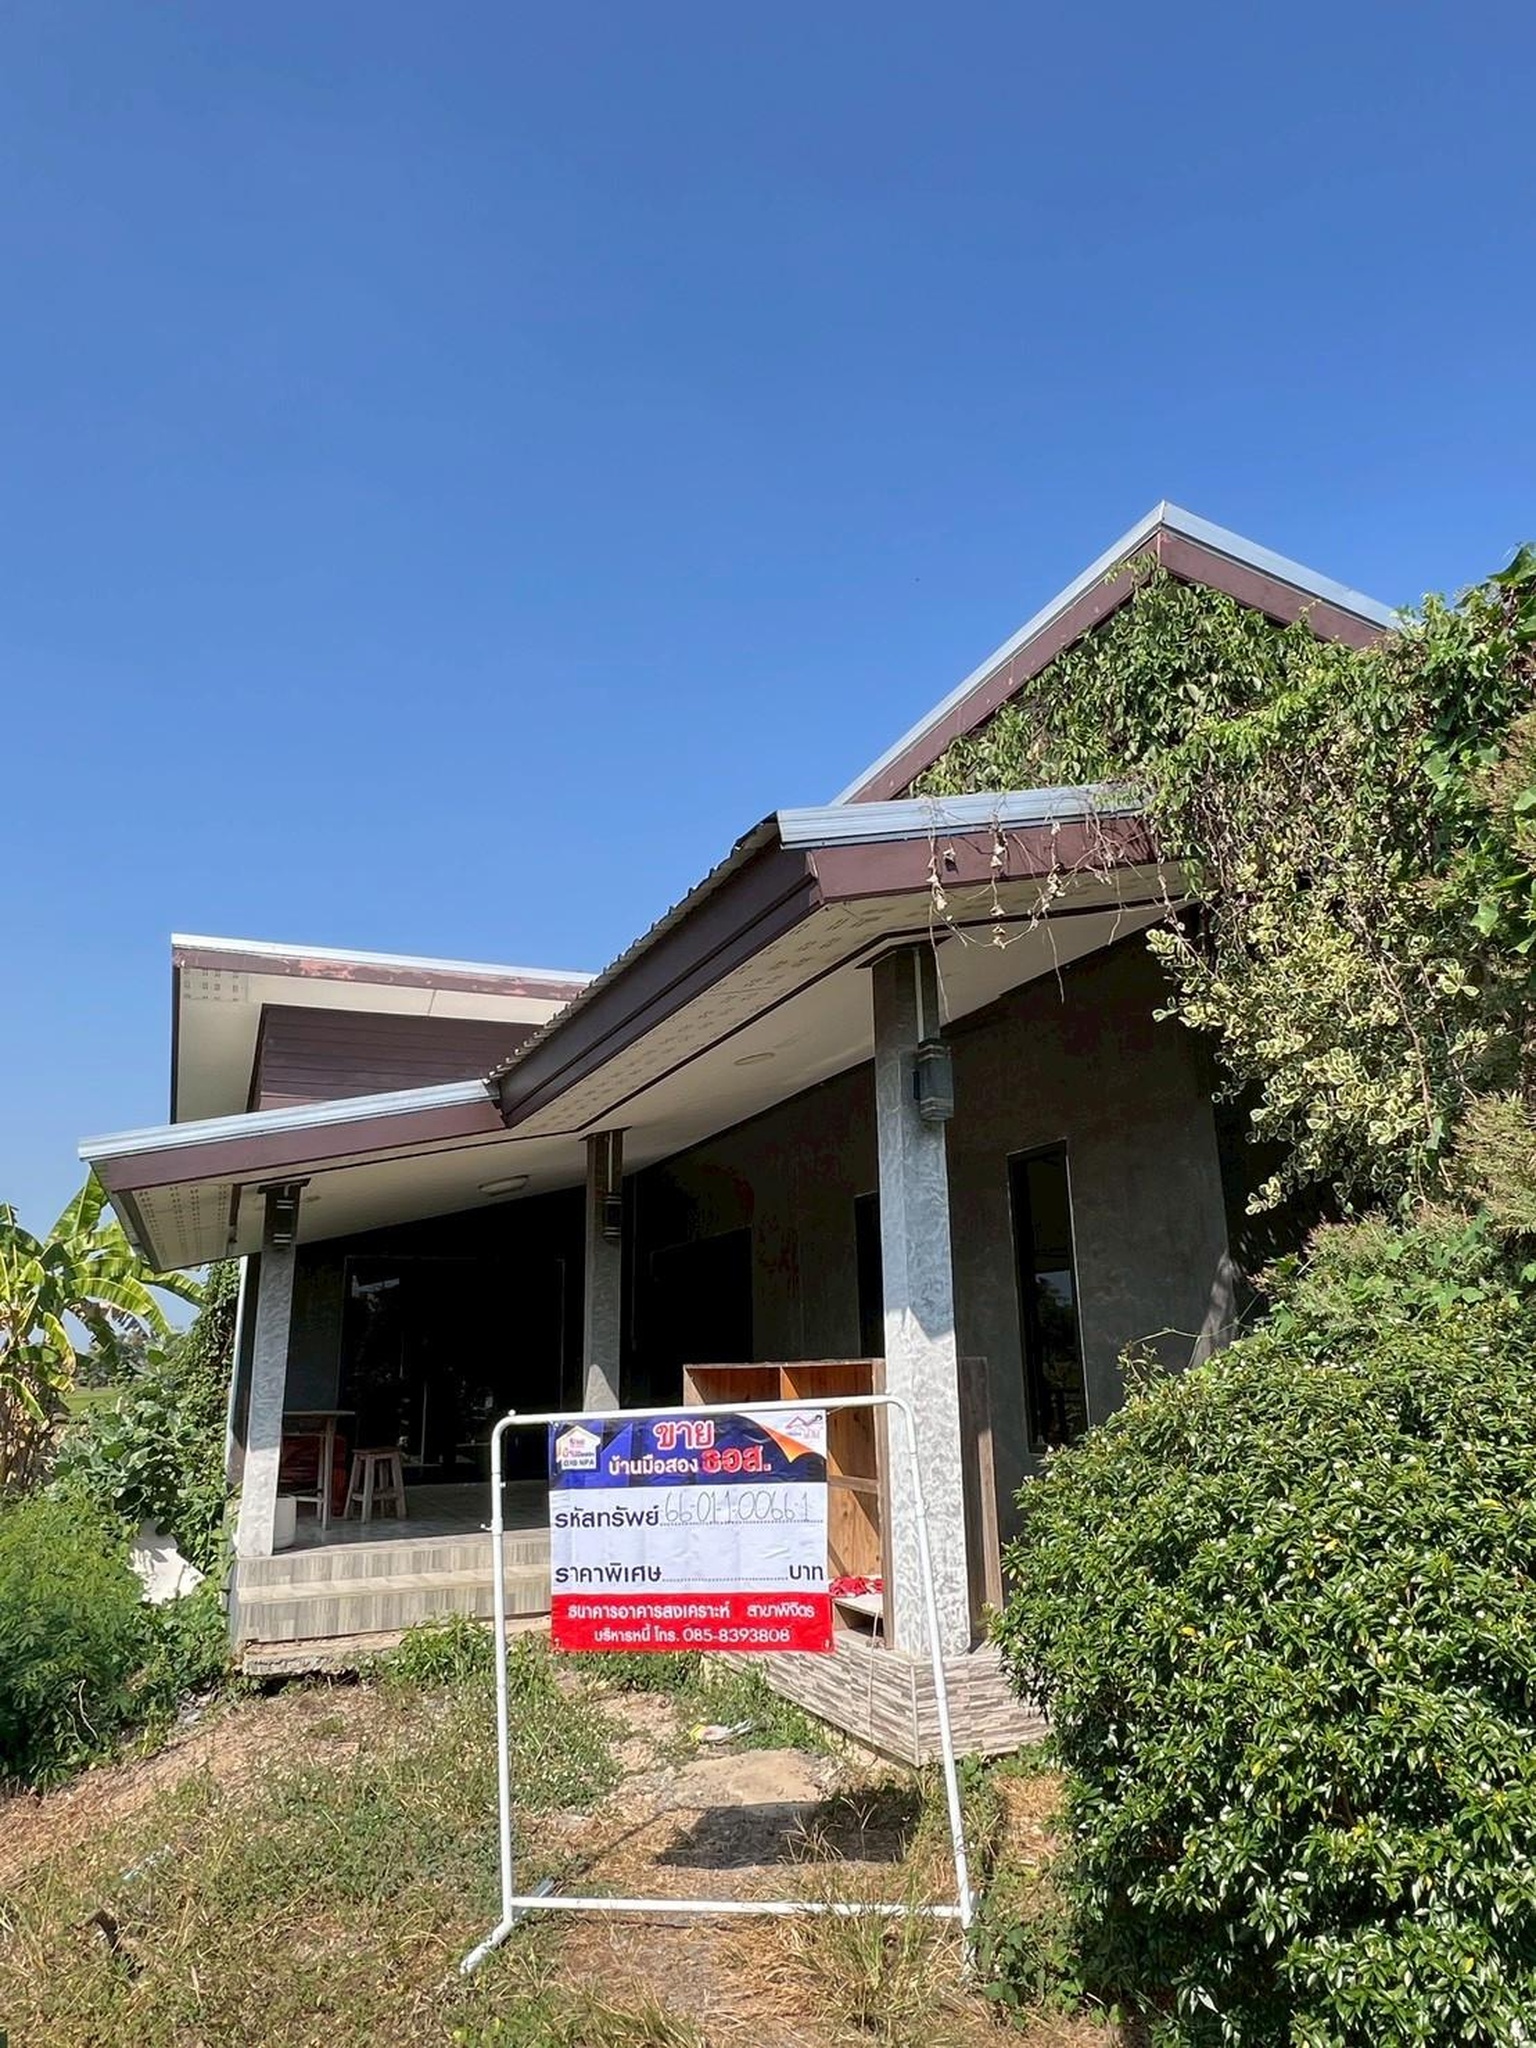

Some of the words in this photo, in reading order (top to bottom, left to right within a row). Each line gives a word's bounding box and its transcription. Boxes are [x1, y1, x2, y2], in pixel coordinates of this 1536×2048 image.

[654, 1420, 715, 1449] ขาย
[609, 1455, 698, 1476] บ้านมือสอง
[702, 1446, 772, 1473] ธอส.
[555, 1505, 660, 1528] รหัสทรัพย์
[555, 1562, 662, 1583] ราคาพิเศษ
[789, 1564, 823, 1581] บาท
[567, 1601, 731, 1619] ธนาคารอาคารสงเคราะห์
[747, 1601, 815, 1619] สาขาพิจิตร
[594, 1622, 650, 1643] บริหารหนี้
[654, 1625, 680, 1642] โทร.
[683, 1627, 790, 1642] 085-8393808
